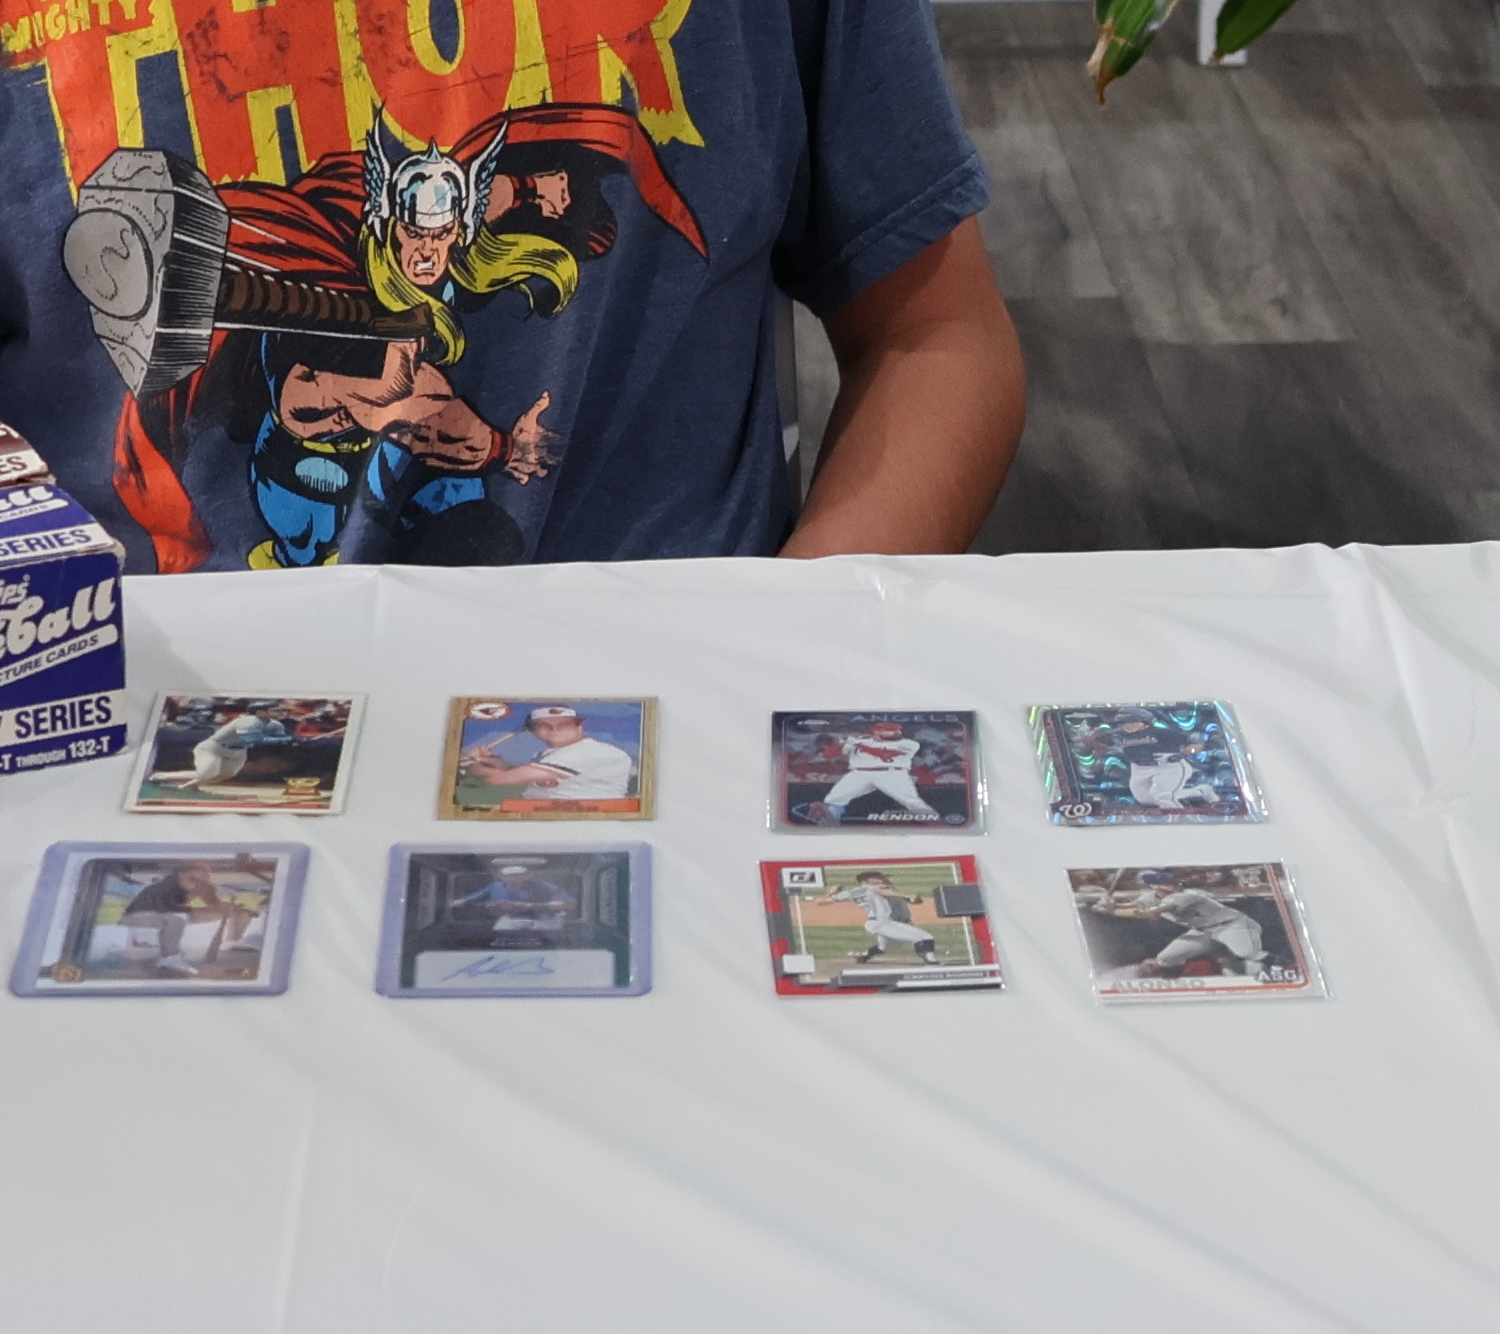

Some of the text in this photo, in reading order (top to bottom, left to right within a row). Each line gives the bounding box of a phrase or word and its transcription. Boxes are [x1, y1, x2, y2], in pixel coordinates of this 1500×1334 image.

[45, 633, 100, 664] CARDS
[14, 694, 113, 740] SERIES
[68, 735, 113, 759] 132-T
[866, 812, 940, 822] RENDON
